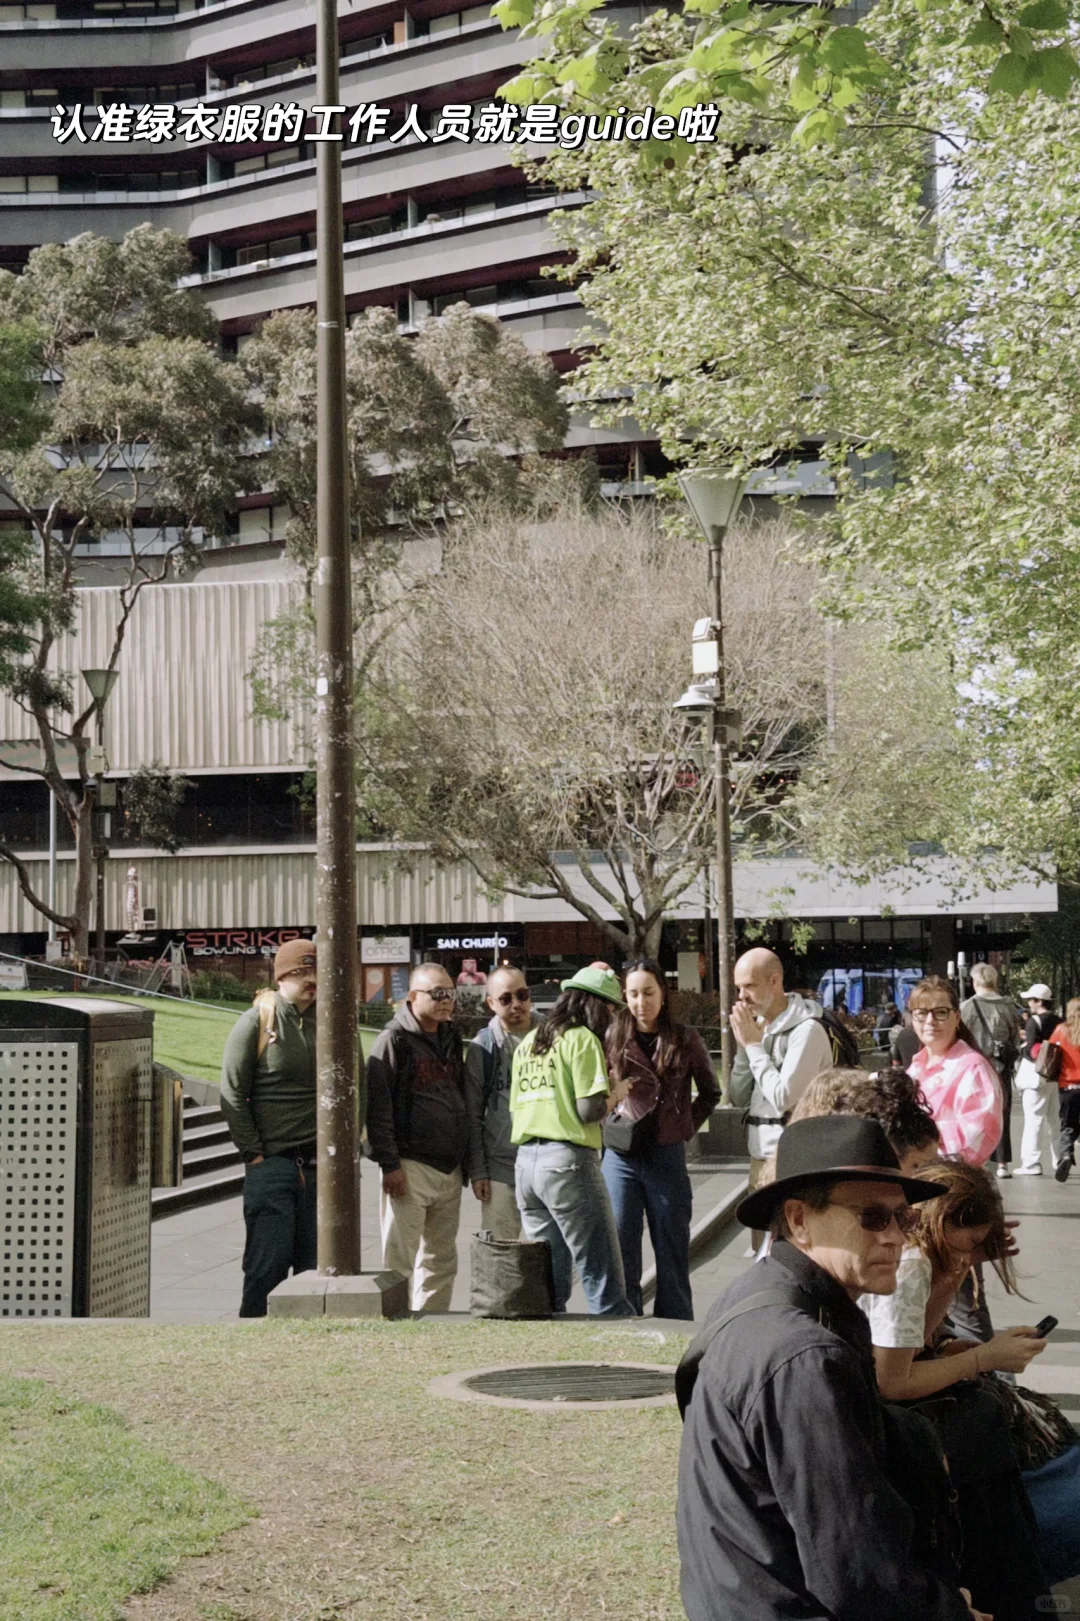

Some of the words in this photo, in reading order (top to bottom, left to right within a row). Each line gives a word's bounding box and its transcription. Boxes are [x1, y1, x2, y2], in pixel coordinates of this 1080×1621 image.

[186, 930, 300, 948] STRIKE
[437, 938, 460, 949] SAN
[193, 946, 256, 956] BOWLING
[548, 1057, 557, 1070] A
